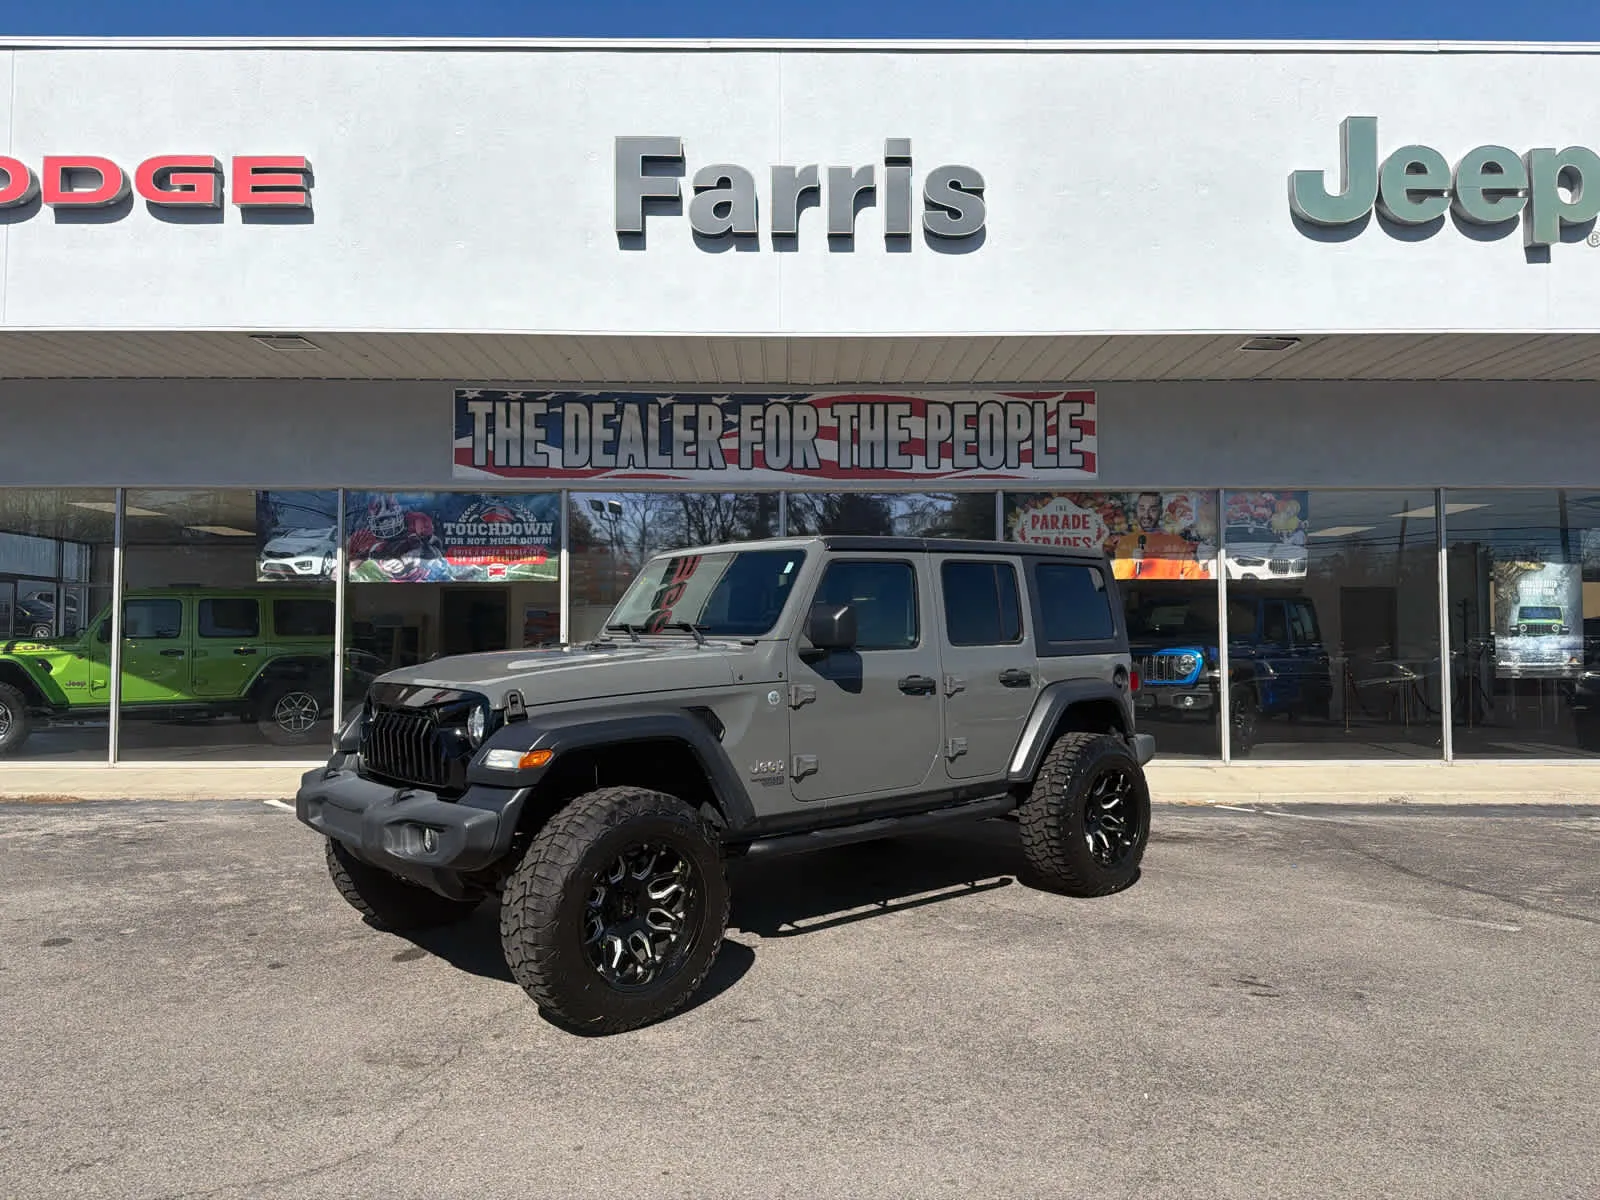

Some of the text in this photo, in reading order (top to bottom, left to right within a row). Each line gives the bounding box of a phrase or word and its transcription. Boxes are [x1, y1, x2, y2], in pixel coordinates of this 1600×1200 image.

[614, 135, 988, 238] Farris
[1288, 116, 1600, 246] Jeep
[467, 400, 1086, 470] THE DEALER FOR THE PEOPLE
[443, 522, 553, 536] TOUCHDOWN
[1031, 514, 1091, 530] PARADE
[444, 537, 464, 545] FOR
[467, 537, 486, 545] NOT
[489, 537, 518, 545] MUCH
[65, 680, 87, 688] Jeep
[751, 759, 785, 774] Jeep
